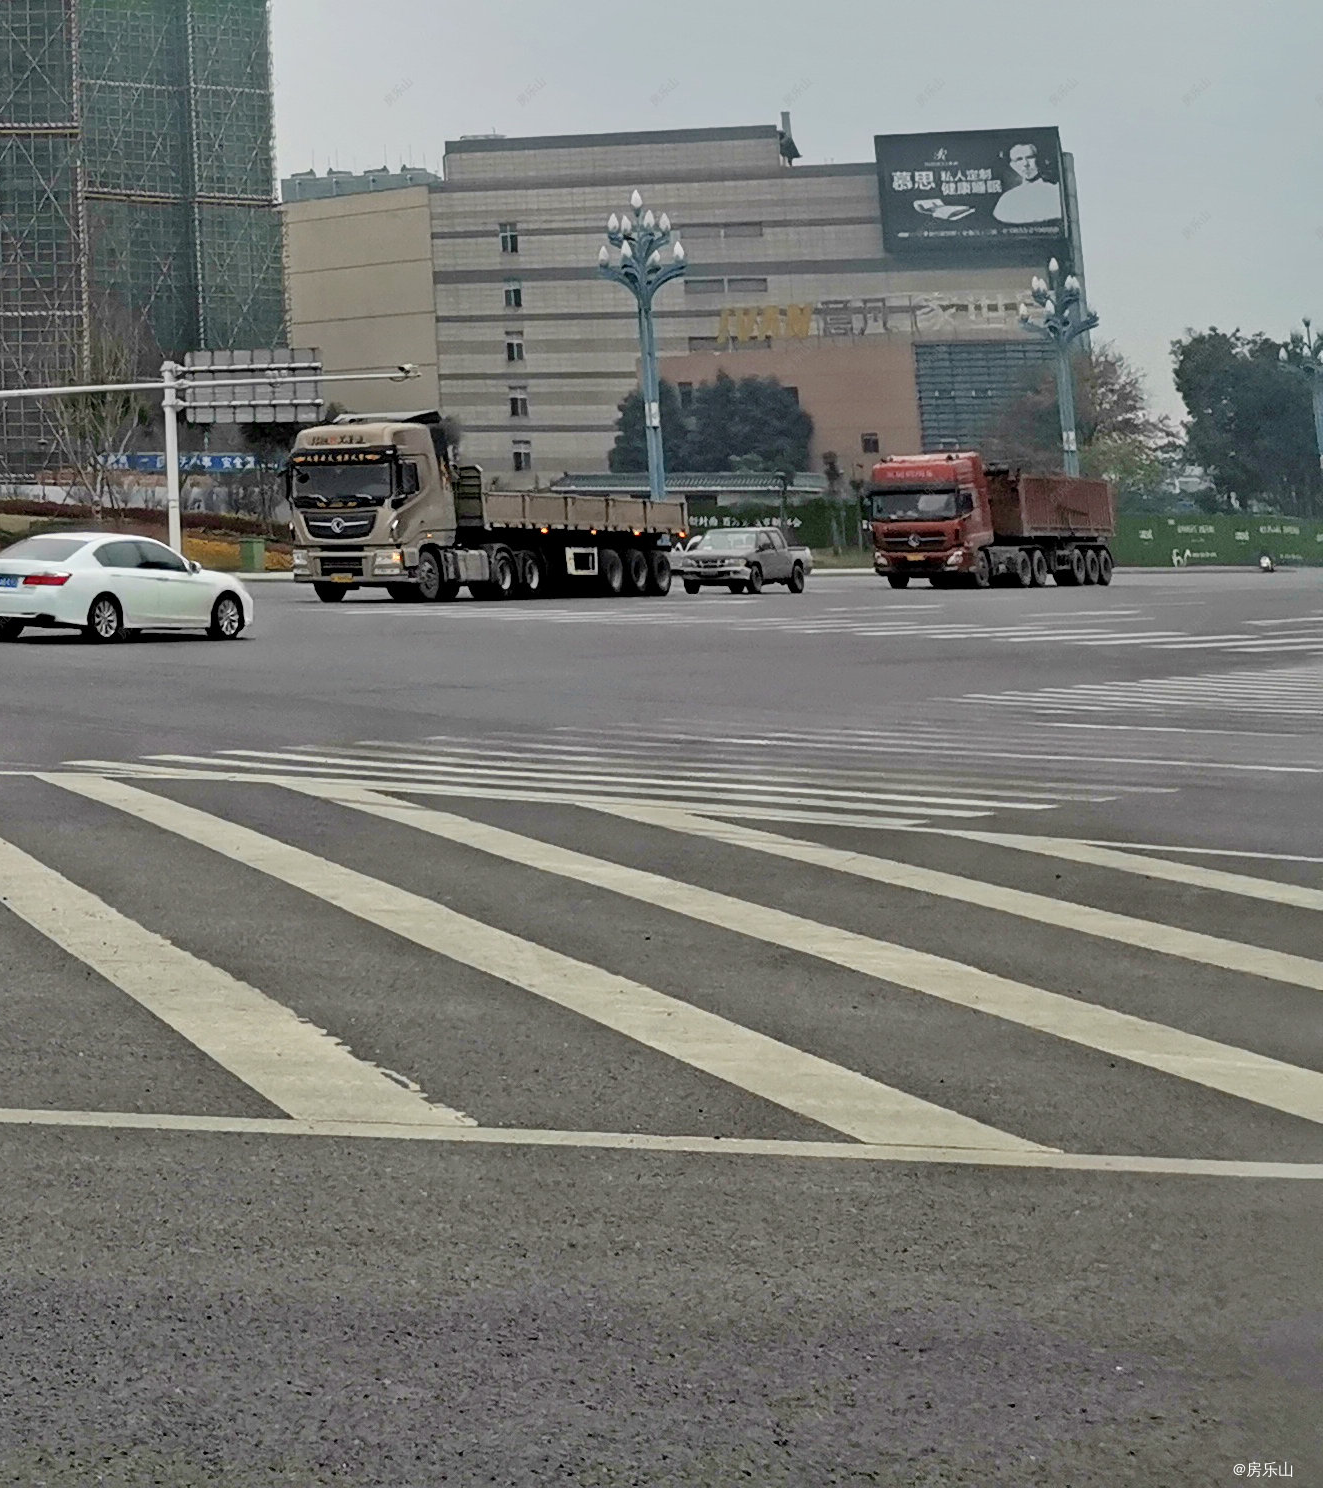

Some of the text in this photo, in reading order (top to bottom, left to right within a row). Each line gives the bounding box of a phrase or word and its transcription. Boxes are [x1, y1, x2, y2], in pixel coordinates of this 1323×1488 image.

[891, 169, 936, 191] 慕思
[940, 168, 992, 182] 私人定制
[941, 180, 1003, 196] 健康睡眠
